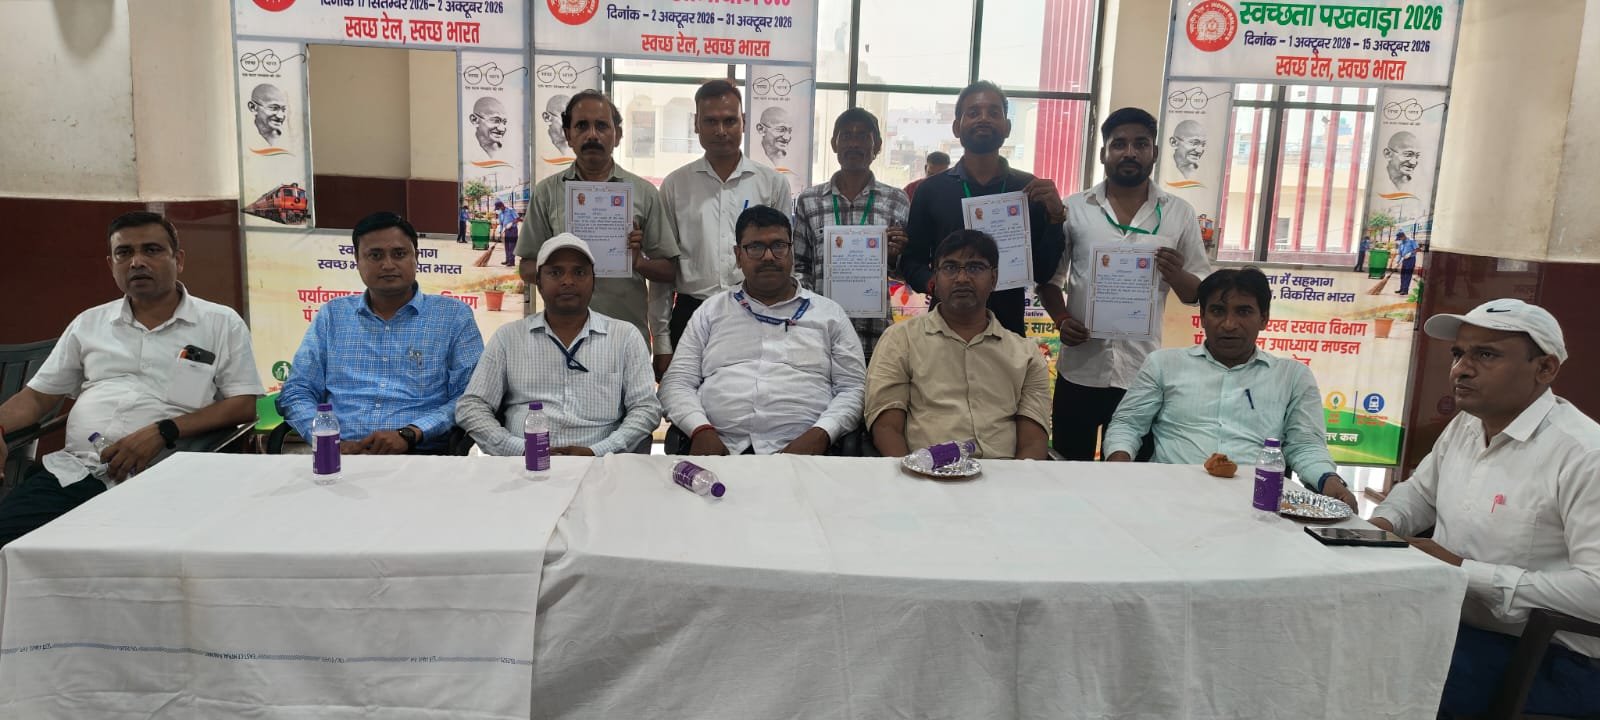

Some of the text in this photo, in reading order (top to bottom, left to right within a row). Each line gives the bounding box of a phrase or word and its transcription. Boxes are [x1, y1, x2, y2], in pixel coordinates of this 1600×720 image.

[438, 0, 443, 11] 2
[445, 1, 482, 18] अक्टूबर
[485, 1, 504, 14] 2026
[607, 4, 640, 21] दिनांक
[652, 10, 656, 21] 2
[659, 11, 696, 28] अक्टूबर
[697, 12, 715, 25] 2026
[726, 13, 735, 26] 31
[737, 15, 773, 32] अक्टूबर
[774, 16, 792, 28] 2026
[344, 11, 481, 45] स्वच्छ रेल, स्वच्छ भारत
[1240, 2, 1444, 38] स्वच्छता पखवाड़ा 2026
[641, 31, 771, 57] स्वच्छ रेल, स्वच्छ भारत
[1244, 31, 1277, 46] दिनांक
[1294, 37, 1331, 54] अक्टूबर
[1333, 37, 1351, 49] 2026
[1363, 38, 1371, 50] 15
[1373, 40, 1410, 57] अक्टूबर
[1412, 40, 1431, 53] 2026
[1276, 53, 1407, 81] स्वच्छ रेल, स्वच्छ भारत
[317, 259, 347, 270] स्वच्छ
[433, 263, 462, 275] भारत
[1279, 273, 1334, 287] में सहभाग
[1280, 286, 1356, 302] विकसित भारत
[1291, 321, 1325, 334] रखाव
[1329, 318, 1368, 337] विभाग
[1269, 338, 1319, 353] उपाध्याय
[1321, 340, 1362, 355] मण्डल
[1339, 432, 1359, 443] कल
